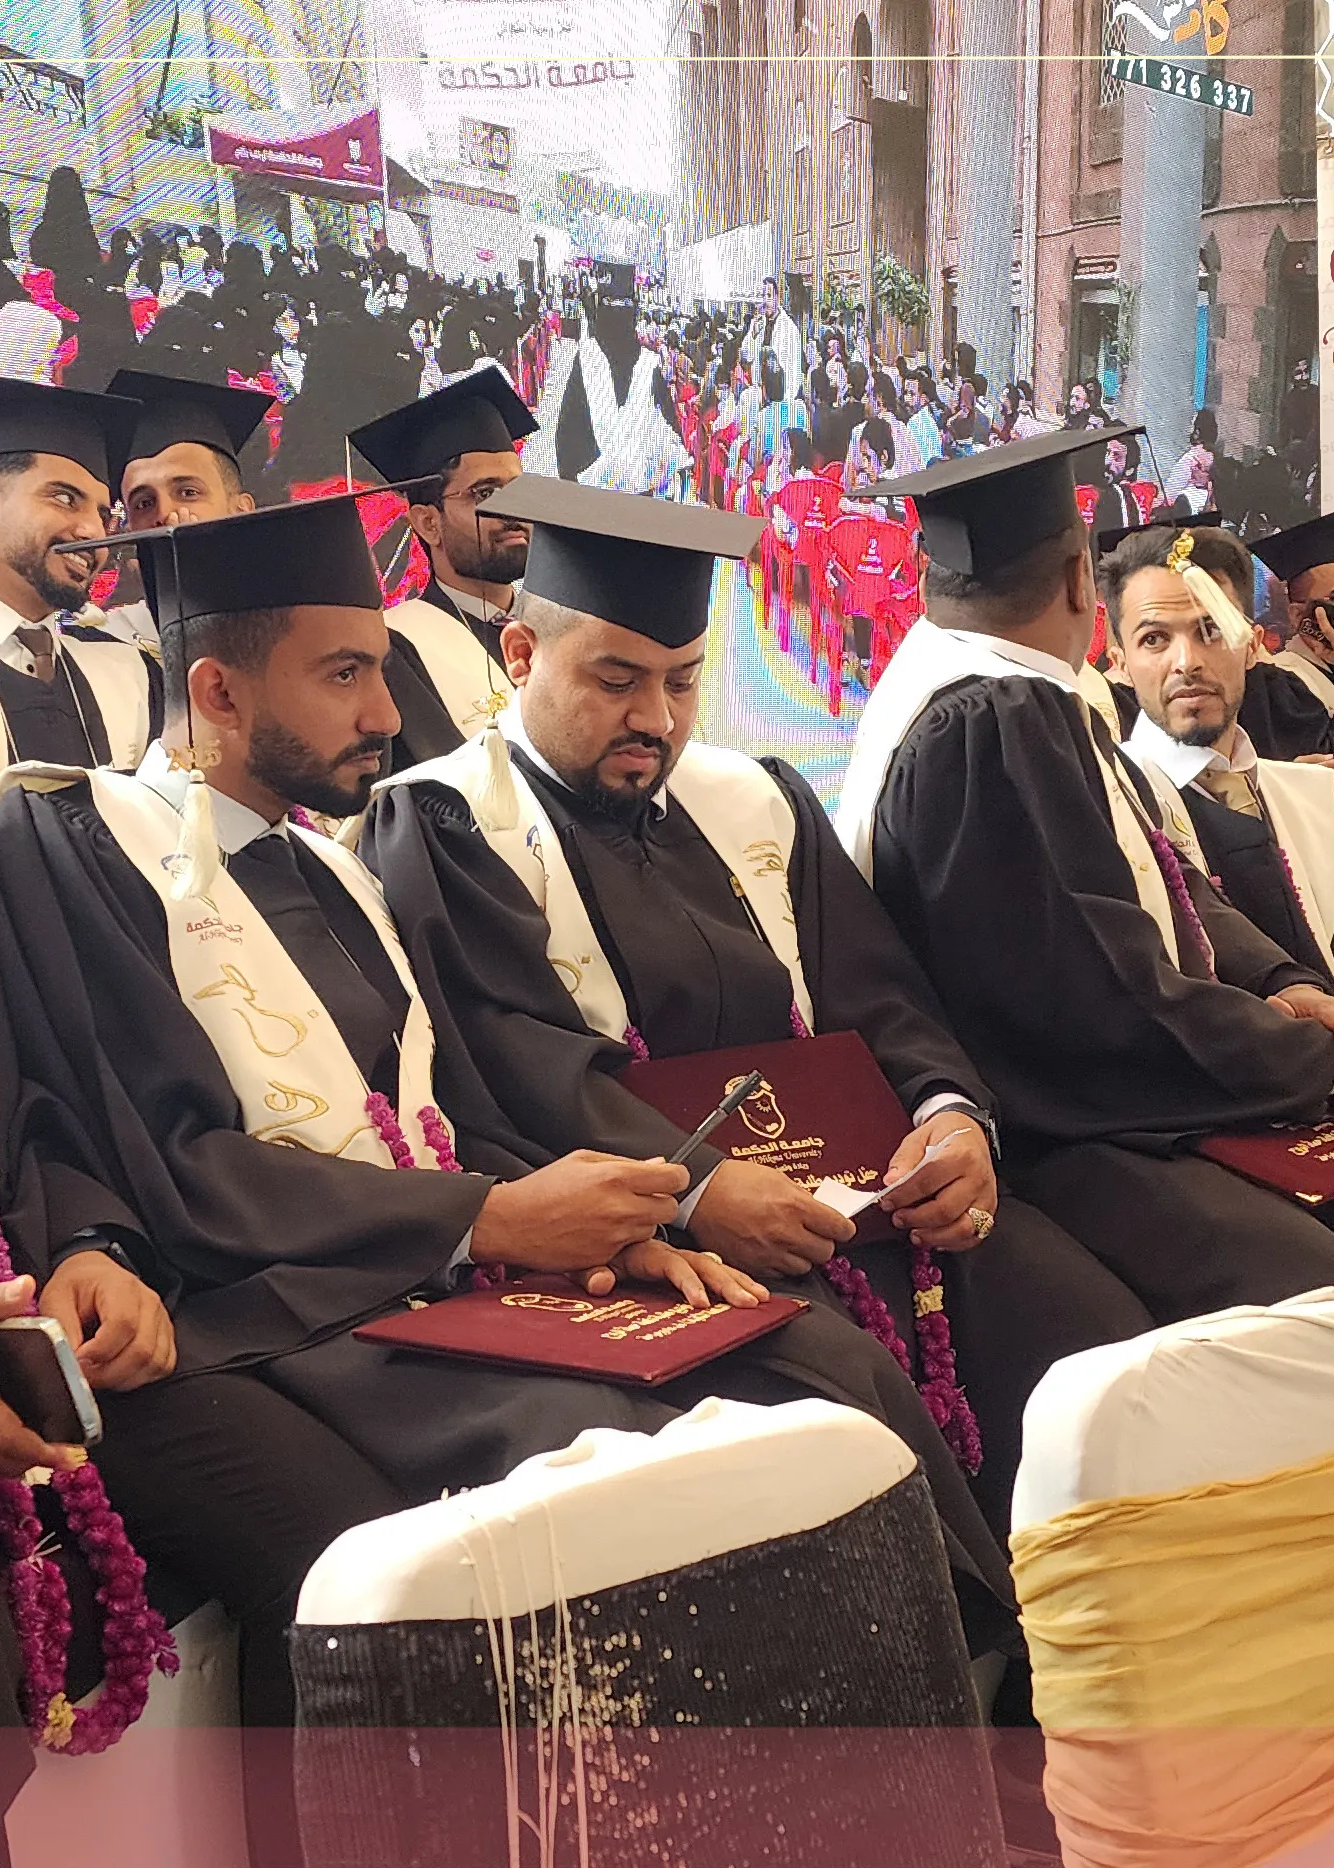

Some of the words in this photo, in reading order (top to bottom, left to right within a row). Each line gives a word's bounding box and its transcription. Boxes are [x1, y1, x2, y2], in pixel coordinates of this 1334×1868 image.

[1160, 64, 1202, 99] 326
[1213, 80, 1252, 113] 337
[731, 1141, 778, 1157] الحكمة
[779, 1136, 825, 1150] جامعة
